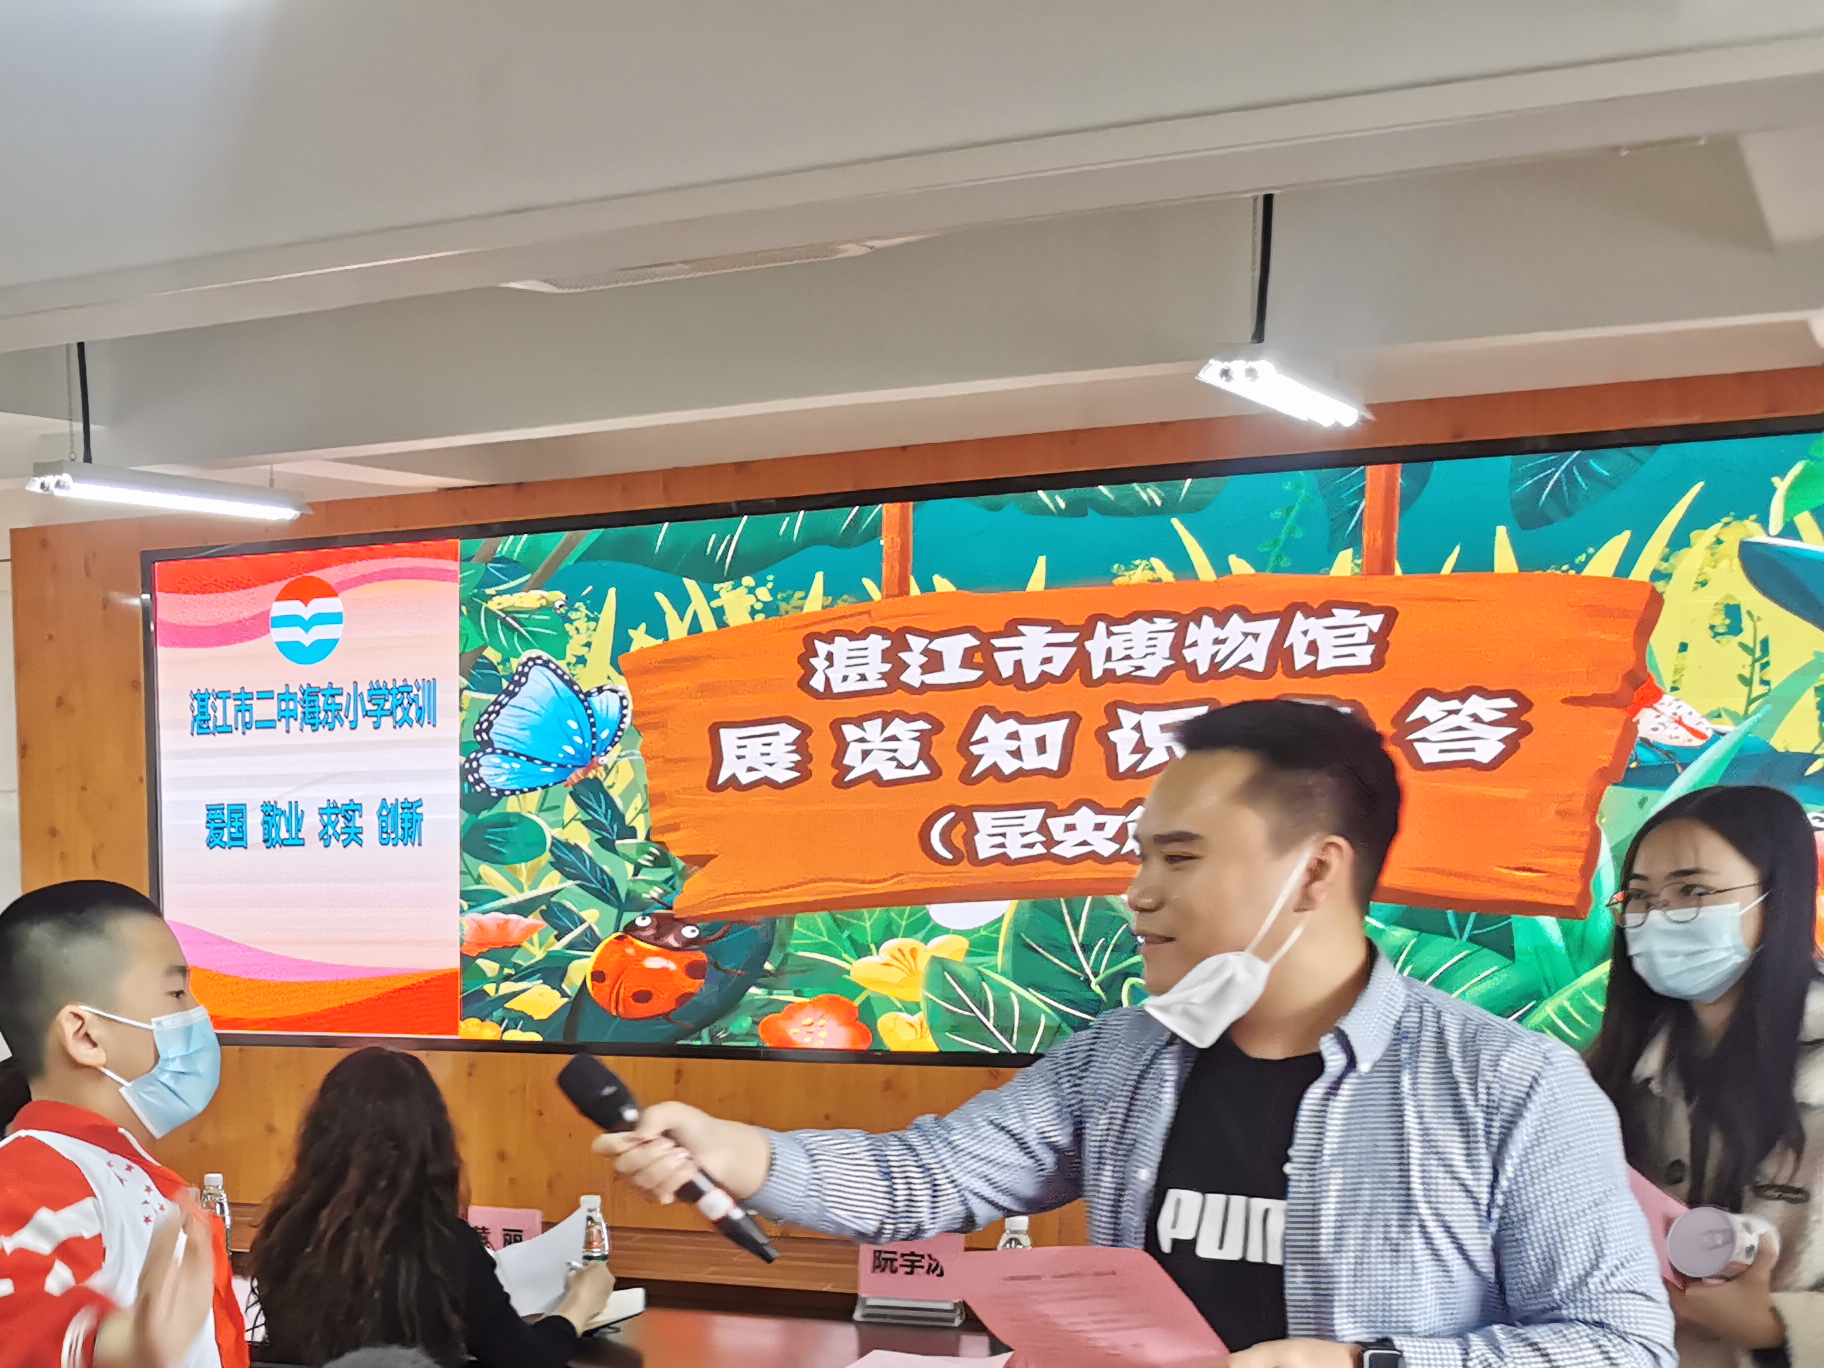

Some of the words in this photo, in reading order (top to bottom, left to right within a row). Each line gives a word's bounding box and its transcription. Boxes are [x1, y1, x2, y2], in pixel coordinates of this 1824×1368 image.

[809, 607, 1385, 693] 湛江市博物馆
[189, 678, 437, 736] 湛江市二中海东小学校训
[716, 694, 1519, 786] 展览知识答
[205, 802, 248, 849] 爱国
[260, 800, 305, 848] 敬业
[318, 799, 363, 848] 求实
[376, 798, 424, 847] 创新
[1157, 1188, 1288, 1265] PUM
